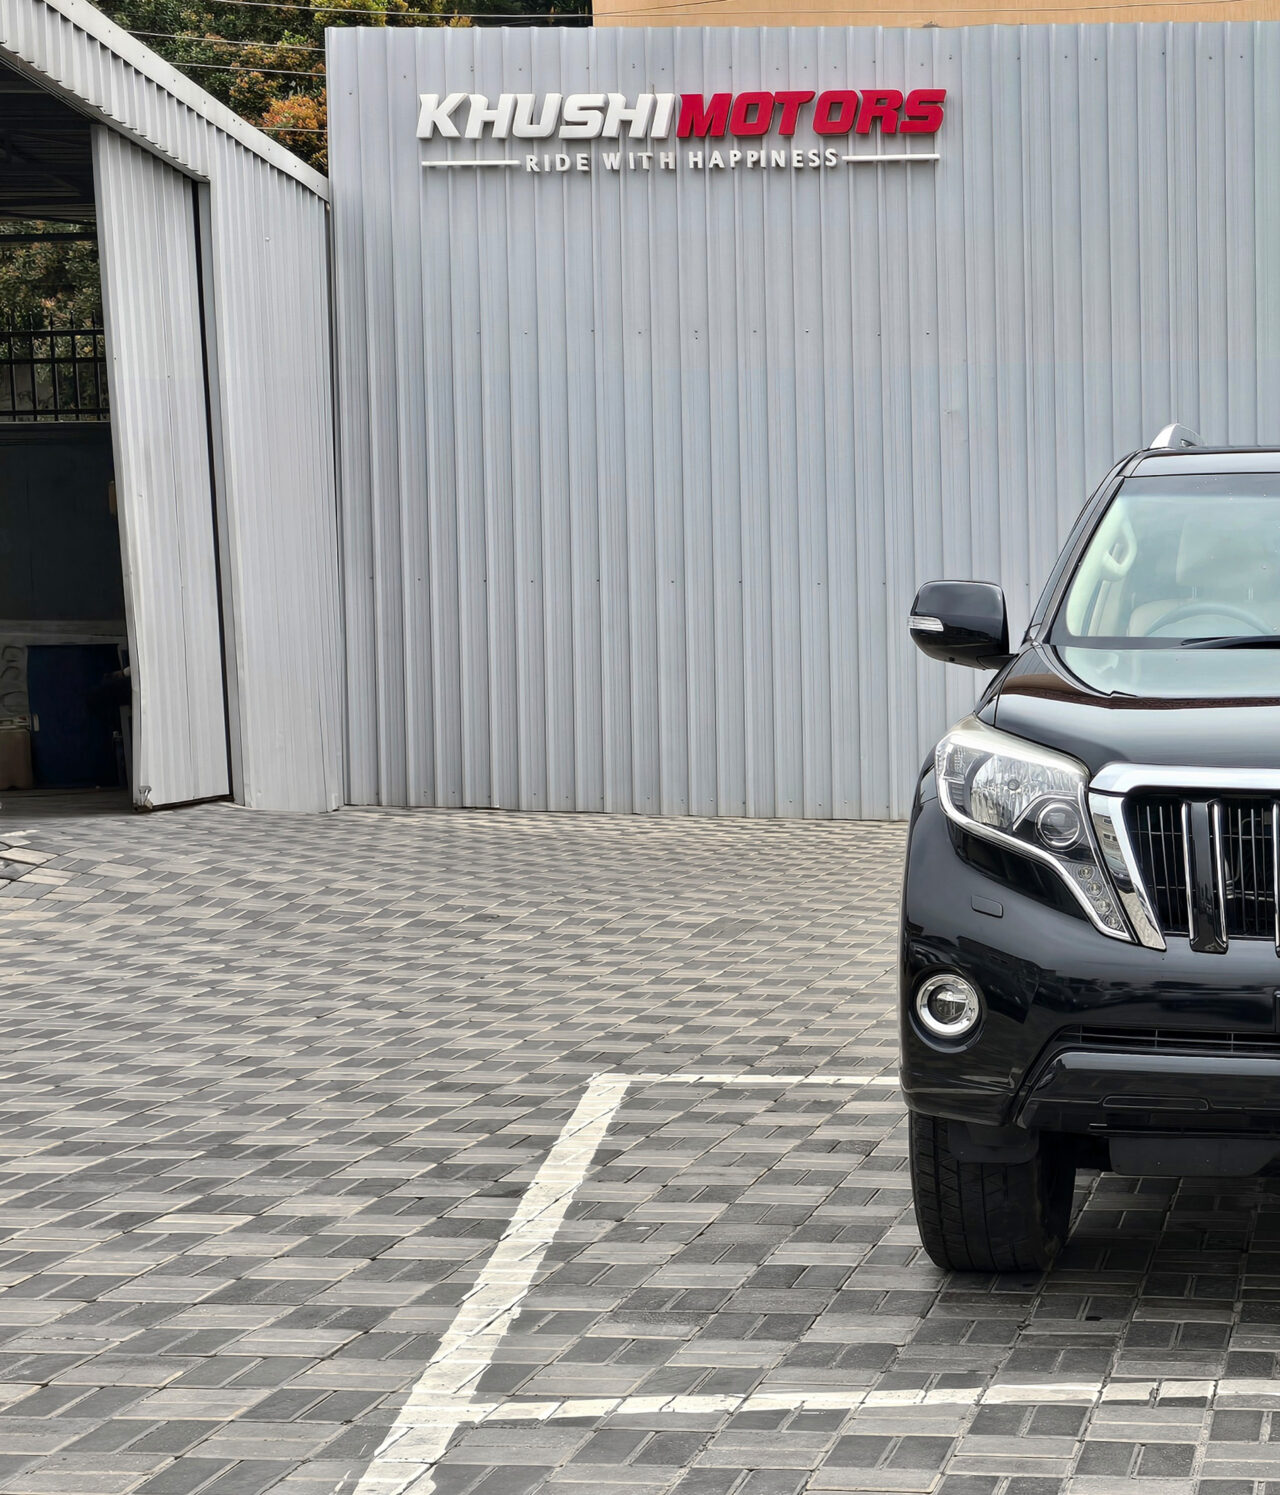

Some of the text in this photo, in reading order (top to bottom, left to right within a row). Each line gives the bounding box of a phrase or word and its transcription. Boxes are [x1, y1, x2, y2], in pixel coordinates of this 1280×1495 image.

[416, 88, 947, 139] KHUSHI MOTORS
[526, 148, 839, 172] RIDE WITH HAPPINESS
